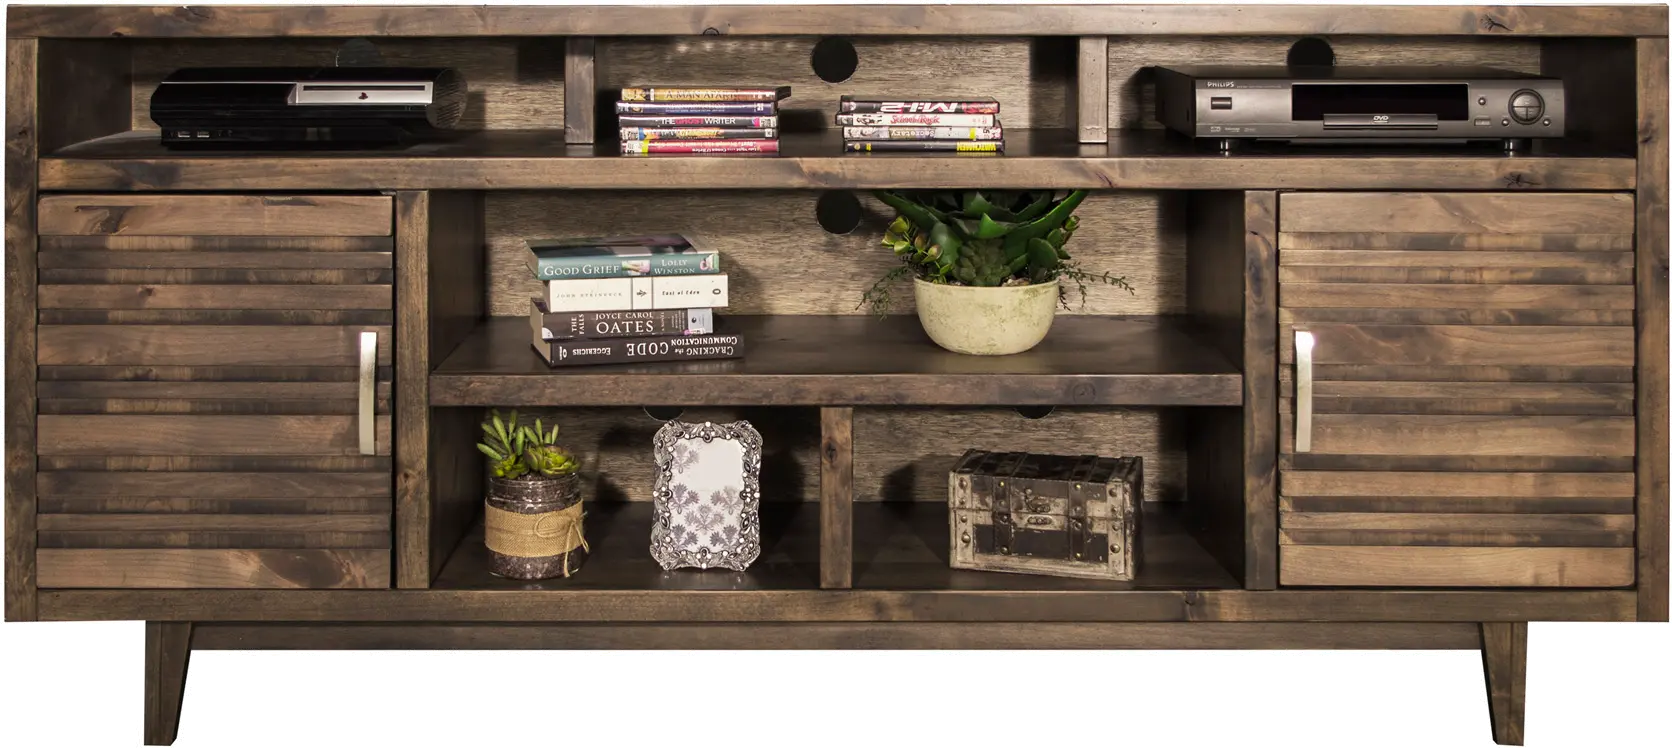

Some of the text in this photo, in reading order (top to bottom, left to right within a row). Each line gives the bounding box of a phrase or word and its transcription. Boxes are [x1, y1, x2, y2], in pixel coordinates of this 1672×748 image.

[665, 91, 673, 99] A
[675, 91, 700, 99] MAN
[660, 117, 736, 125] THE GHOST WRITER
[890, 129, 936, 138] Secretary
[956, 142, 997, 151] WATCHMEN
[661, 259, 688, 267] LOLLY
[543, 264, 620, 277] GOOD GRIEF
[653, 267, 696, 275] WINSTON
[595, 311, 654, 321] JOYCE CAROL
[595, 320, 655, 334] OATES
[670, 336, 738, 347] COMMUNICATION
[572, 347, 612, 357] EGGERICHS
[626, 341, 669, 356] CODE
[686, 346, 734, 356] CRACKING
